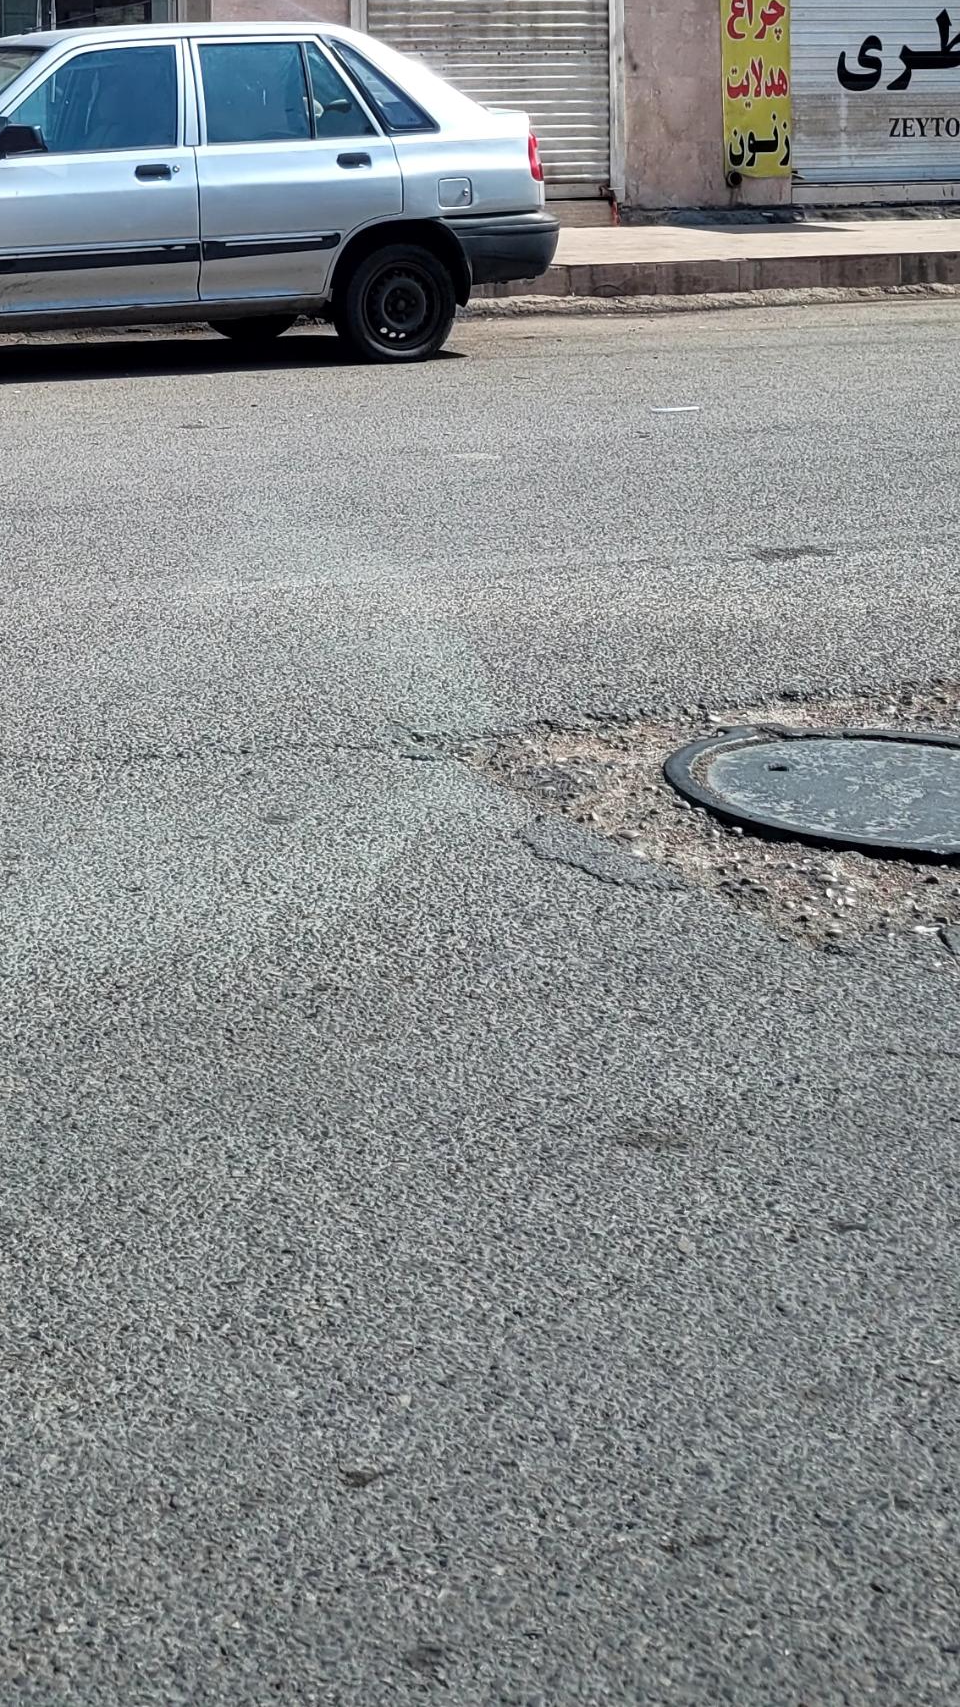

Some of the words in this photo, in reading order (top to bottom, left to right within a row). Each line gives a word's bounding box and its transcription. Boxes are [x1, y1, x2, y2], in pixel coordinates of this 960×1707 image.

[726, 56, 788, 108] هدلایت
[729, 113, 791, 167] زنون
[889, 118, 960, 137] ZEYTO
